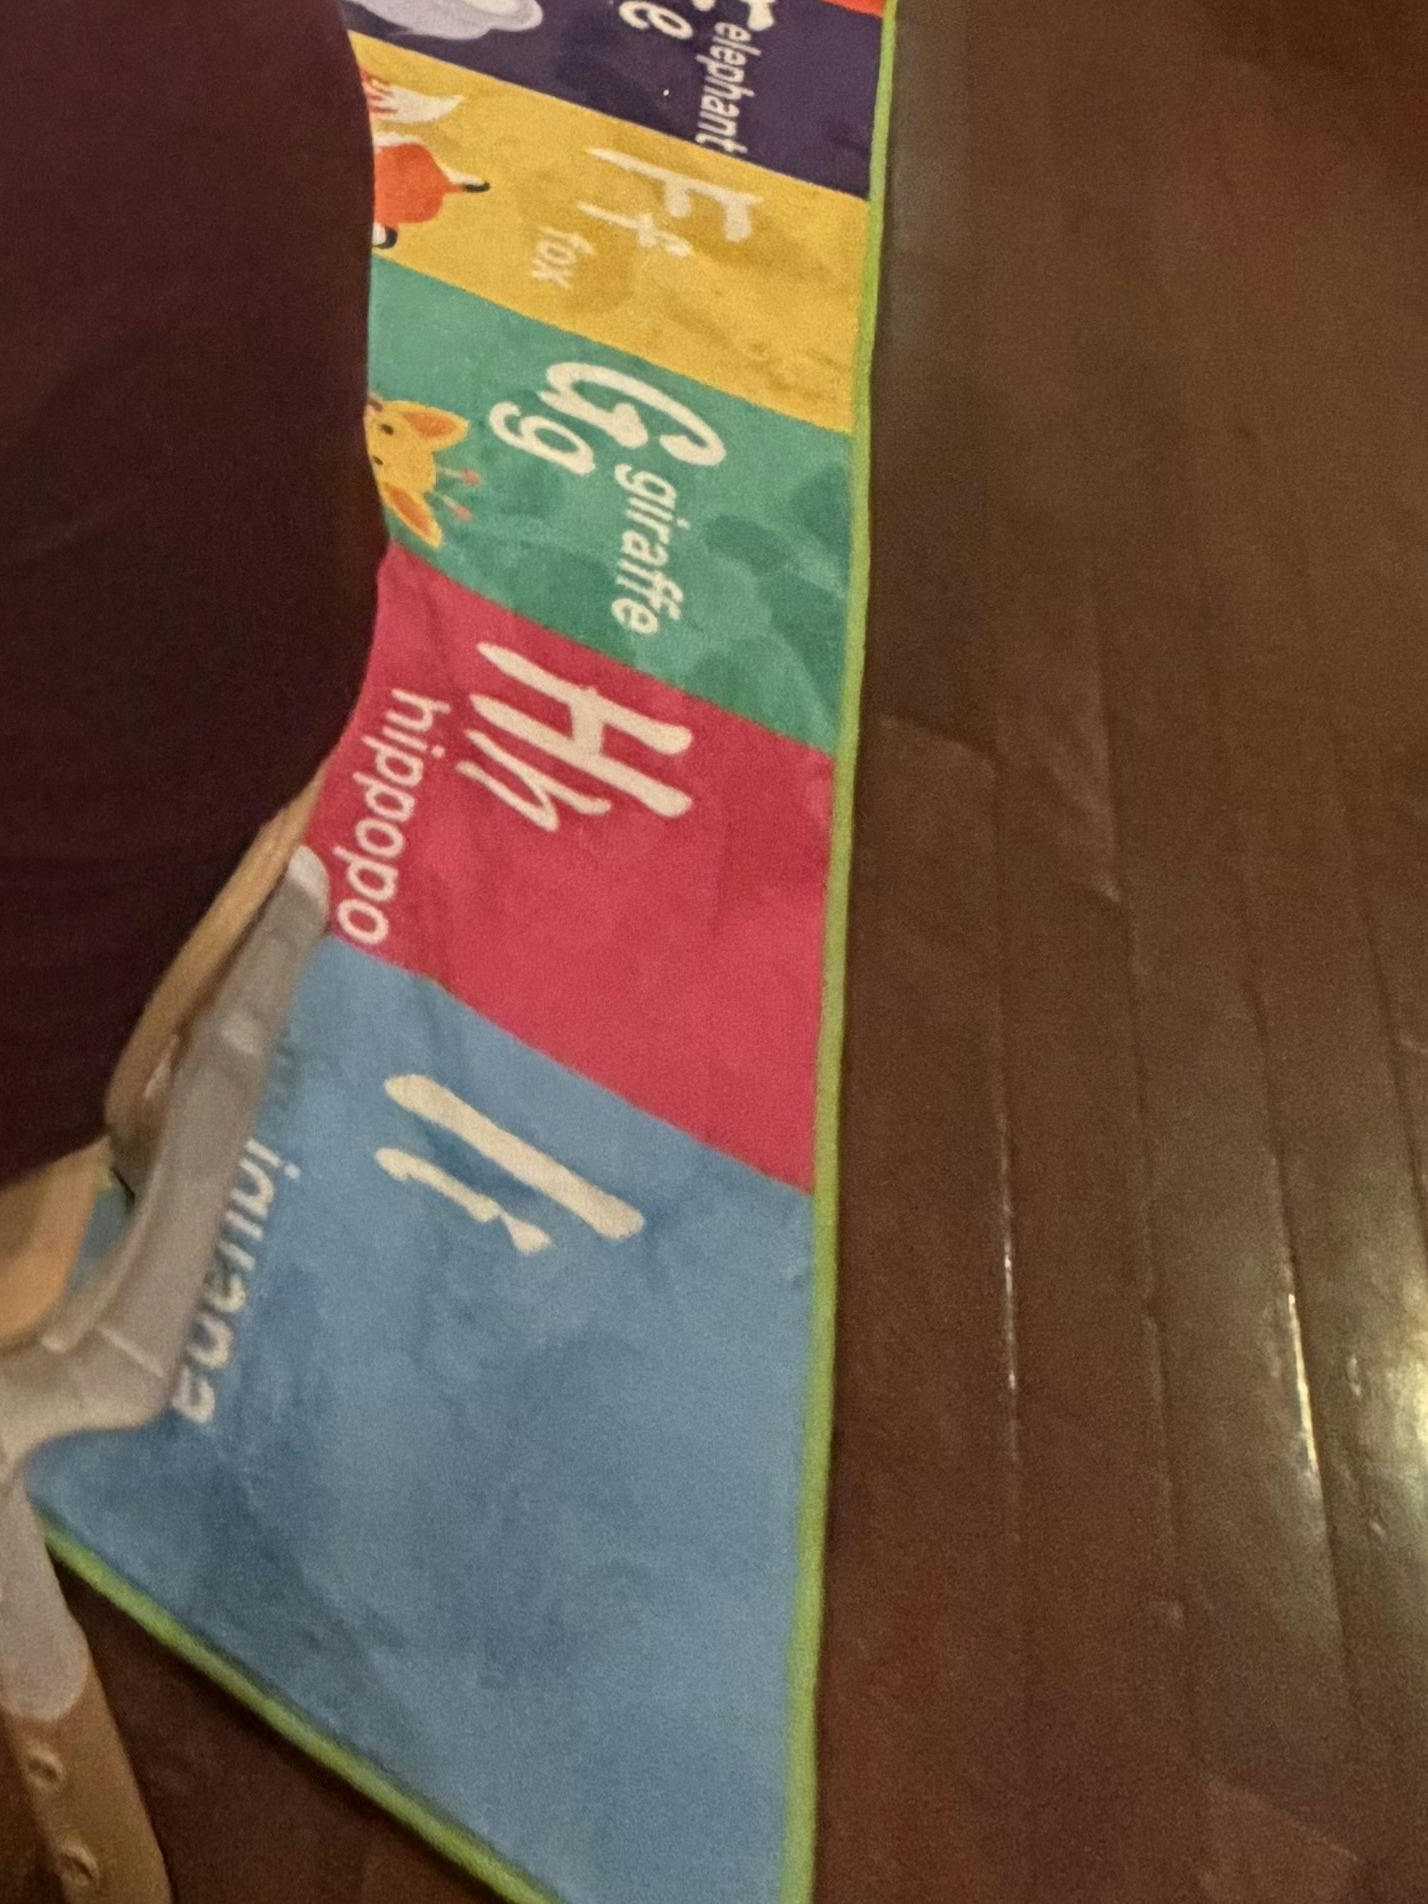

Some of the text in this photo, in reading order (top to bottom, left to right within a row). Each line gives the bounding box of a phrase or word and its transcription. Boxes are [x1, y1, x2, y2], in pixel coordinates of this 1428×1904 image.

[693, 20, 762, 156] elephant
[530, 225, 597, 290] fox
[610, 463, 682, 636] giraffe
[337, 686, 452, 948] hippopo
